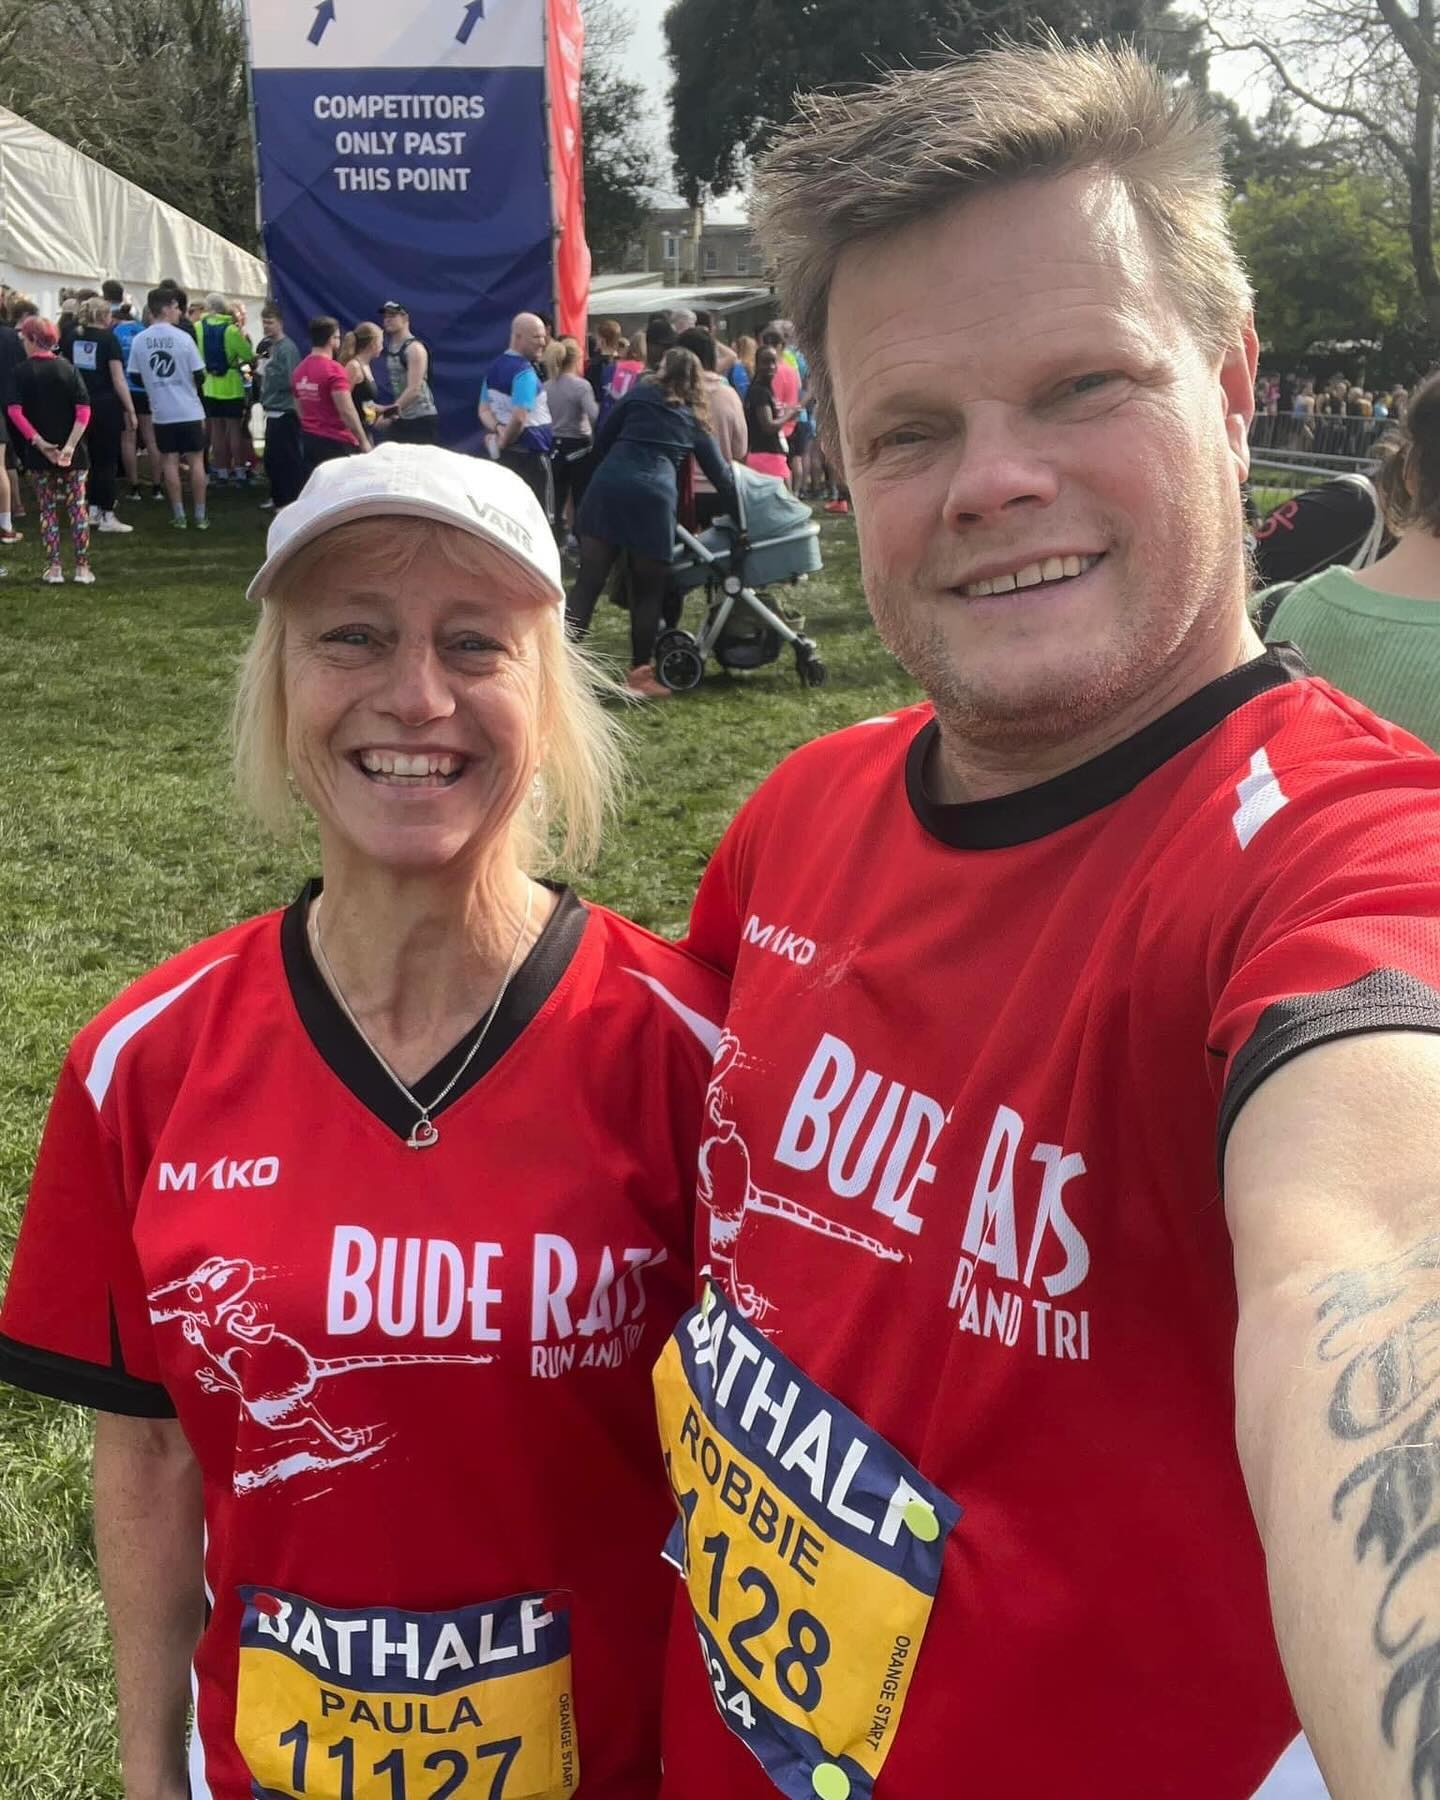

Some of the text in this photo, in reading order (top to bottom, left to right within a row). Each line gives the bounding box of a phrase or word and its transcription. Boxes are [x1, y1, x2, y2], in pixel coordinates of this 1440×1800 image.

[313, 95, 486, 119] COMPETITORS
[335, 131, 467, 156] ONLY PAST
[333, 166, 472, 191] THIS POINT
[466, 494, 534, 554] VANS
[158, 1155, 280, 1191] MAKO
[327, 1225, 668, 1342] BUDE RATS
[531, 1344, 576, 1379] RUN
[579, 1336, 623, 1368] AND
[1032, 1300, 1090, 1360] TRI
[679, 1404, 825, 1587] ROBBIE
[257, 1597, 555, 1681] BATHALF
[319, 1688, 484, 1735] PAULA
[865, 1634, 912, 1752] ORANGE START
[278, 1720, 523, 1800] 11127
[559, 1693, 574, 1789] ORANGE START
